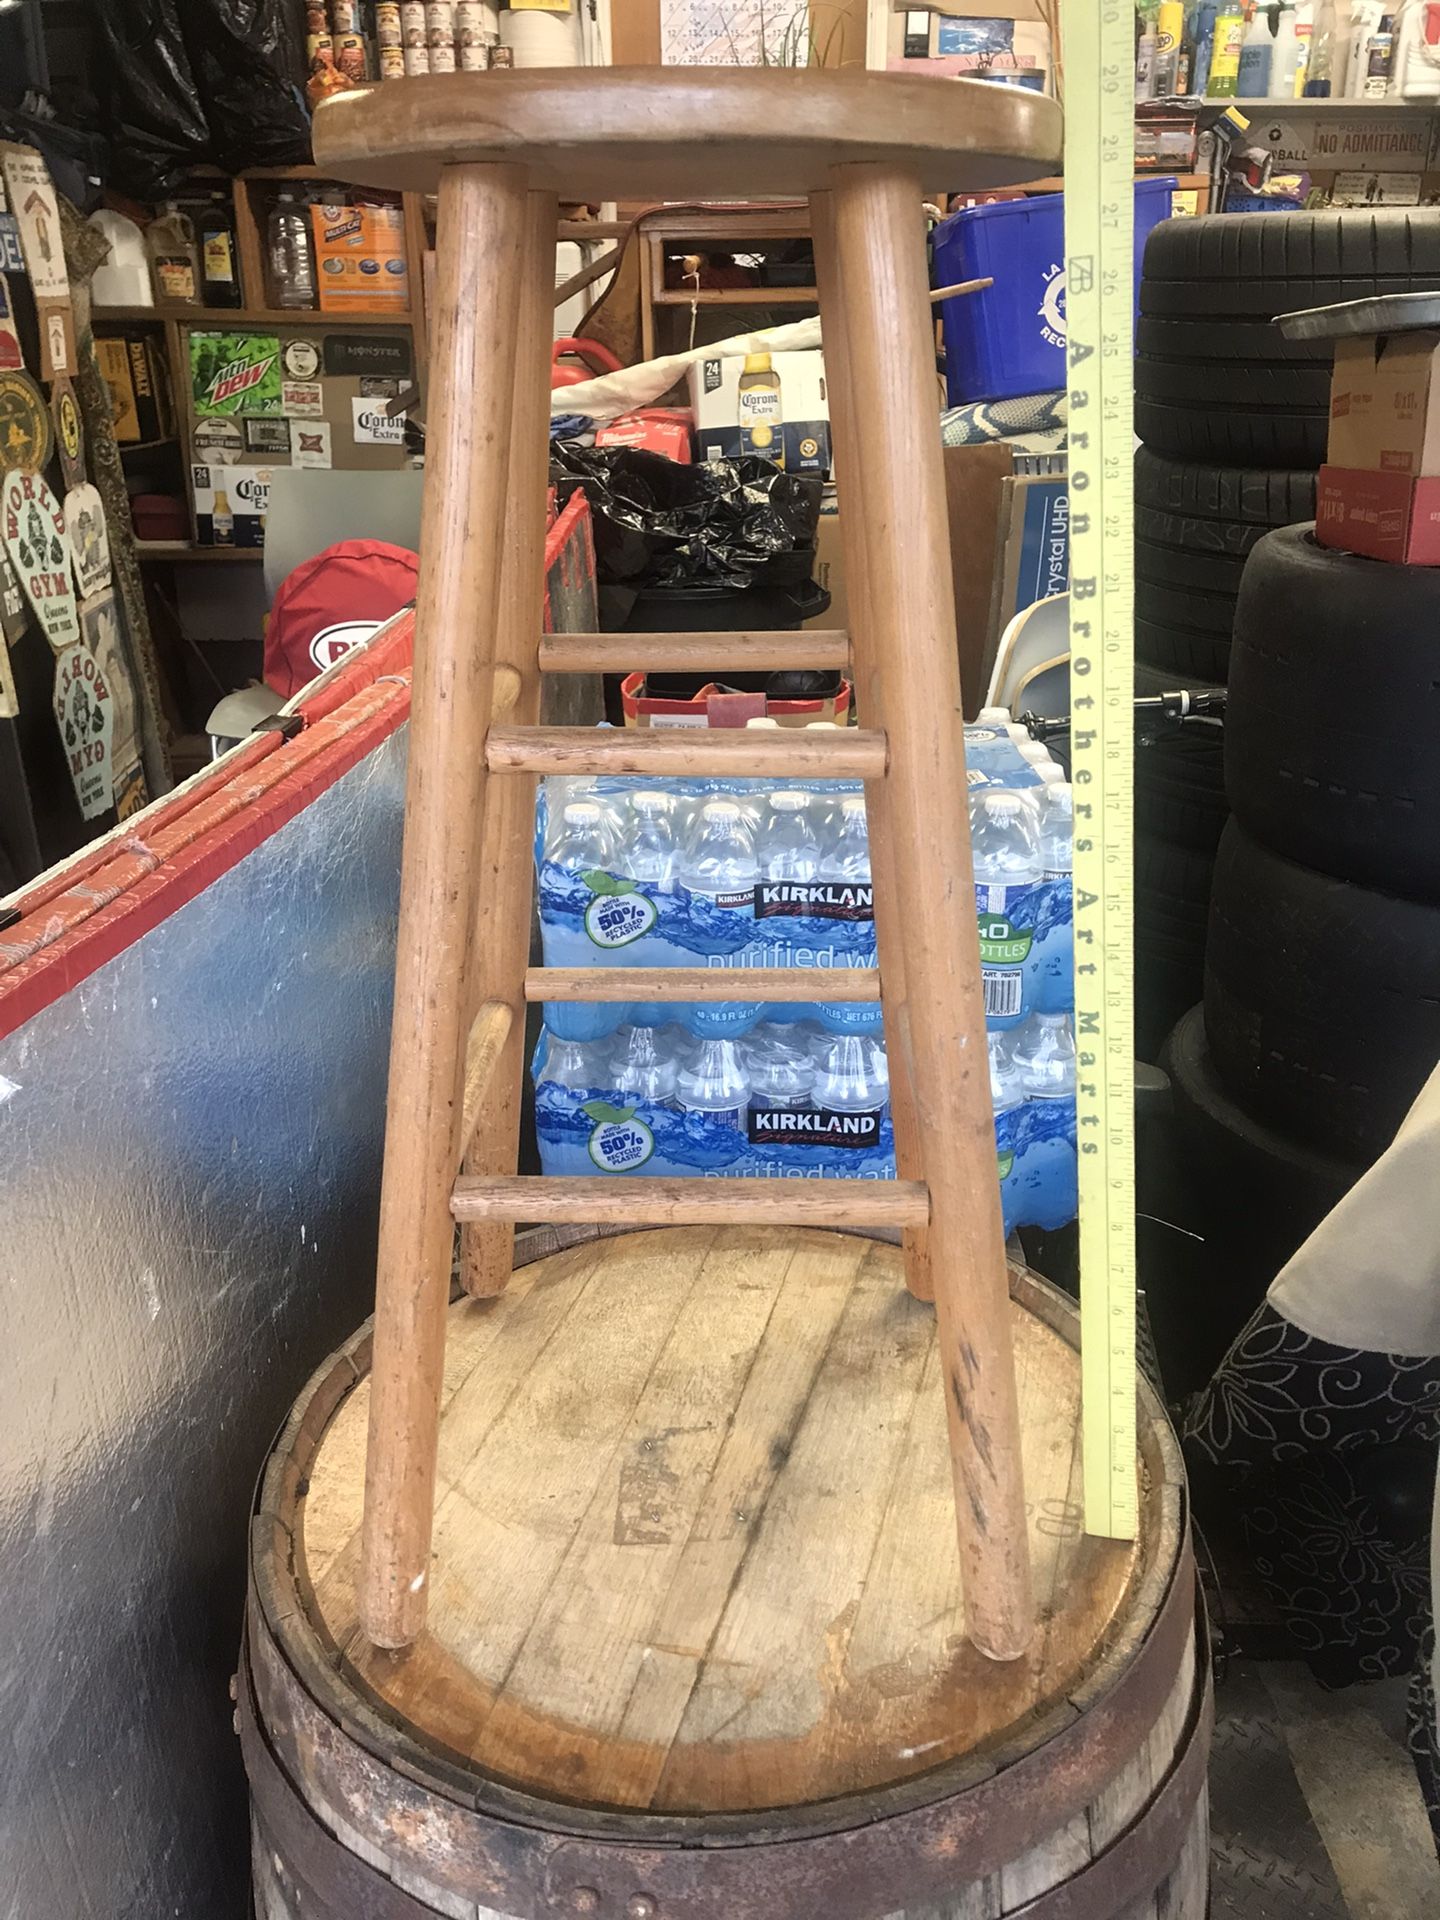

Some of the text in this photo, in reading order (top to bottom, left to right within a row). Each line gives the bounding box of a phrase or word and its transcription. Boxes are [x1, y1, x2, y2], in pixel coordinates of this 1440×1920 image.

[1101, 65, 1119, 95] 29
[1102, 135, 1119, 163] 28
[1318, 133, 1424, 153] NO ADMITTANCE
[1102, 202, 1119, 230] 27
[1042, 263, 1061, 282] LA
[1102, 269, 1119, 297] 26
[1102, 333, 1119, 358] 25
[130, 342, 151, 397] DEWALT
[706, 361, 720, 376] 24
[742, 391, 779, 408] Corona
[1104, 396, 1119, 421] 24
[752, 405, 773, 415] Extra
[357, 411, 405, 431] Coron
[372, 427, 401, 440] Extra
[195, 468, 208, 479] 24
[1104, 456, 1120, 480] 23
[236, 479, 271, 501] Cor
[7, 476, 66, 541] WORLD
[1051, 495, 1069, 536] UHD
[1105, 515, 1120, 538] 22
[30, 572, 70, 600] GYM
[1105, 573, 1120, 593] 21
[1105, 630, 1120, 653] 20
[1105, 685, 1120, 707] 19
[1069, 338, 1101, 1155] Aaron Brothers Art Marts
[1106, 738, 1121, 760] 18
[1106, 792, 1121, 811] 17
[1106, 844, 1121, 864] 16
[1043, 871, 1072, 880] IRKLA
[718, 892, 755, 904] KIRKLAN
[763, 886, 873, 906] KIRKLAN
[1106, 894, 1121, 912] 15
[597, 905, 645, 931] 50%
[764, 904, 874, 917] Signatur
[605, 918, 643, 937] RECYCLED
[610, 924, 642, 940] PLASTIC
[980, 942, 1026, 957] OTTLES
[1107, 942, 1121, 960] 14
[1107, 991, 1121, 1008] 13
[814, 1004, 841, 1019] TTLES
[1108, 1036, 1122, 1054] 12
[1109, 1083, 1122, 1098] 11
[756, 1113, 876, 1134] KIRKLAND
[600, 1131, 644, 1155] 50%
[756, 1131, 876, 1145] Signature
[1109, 1128, 1123, 1146] 10
[607, 1146, 642, 1161] RECYCLED
[612, 1152, 641, 1165] PLASTIC
[1110, 1181, 1124, 1190] 9
[1111, 1224, 1124, 1232] 8
[1111, 1265, 1125, 1274] 7
[1112, 1307, 1124, 1317] 6
[1112, 1346, 1125, 1356] 5
[1112, 1386, 1126, 1397] 4
[1113, 1425, 1126, 1435] 3
[1112, 1465, 1125, 1474] 2
